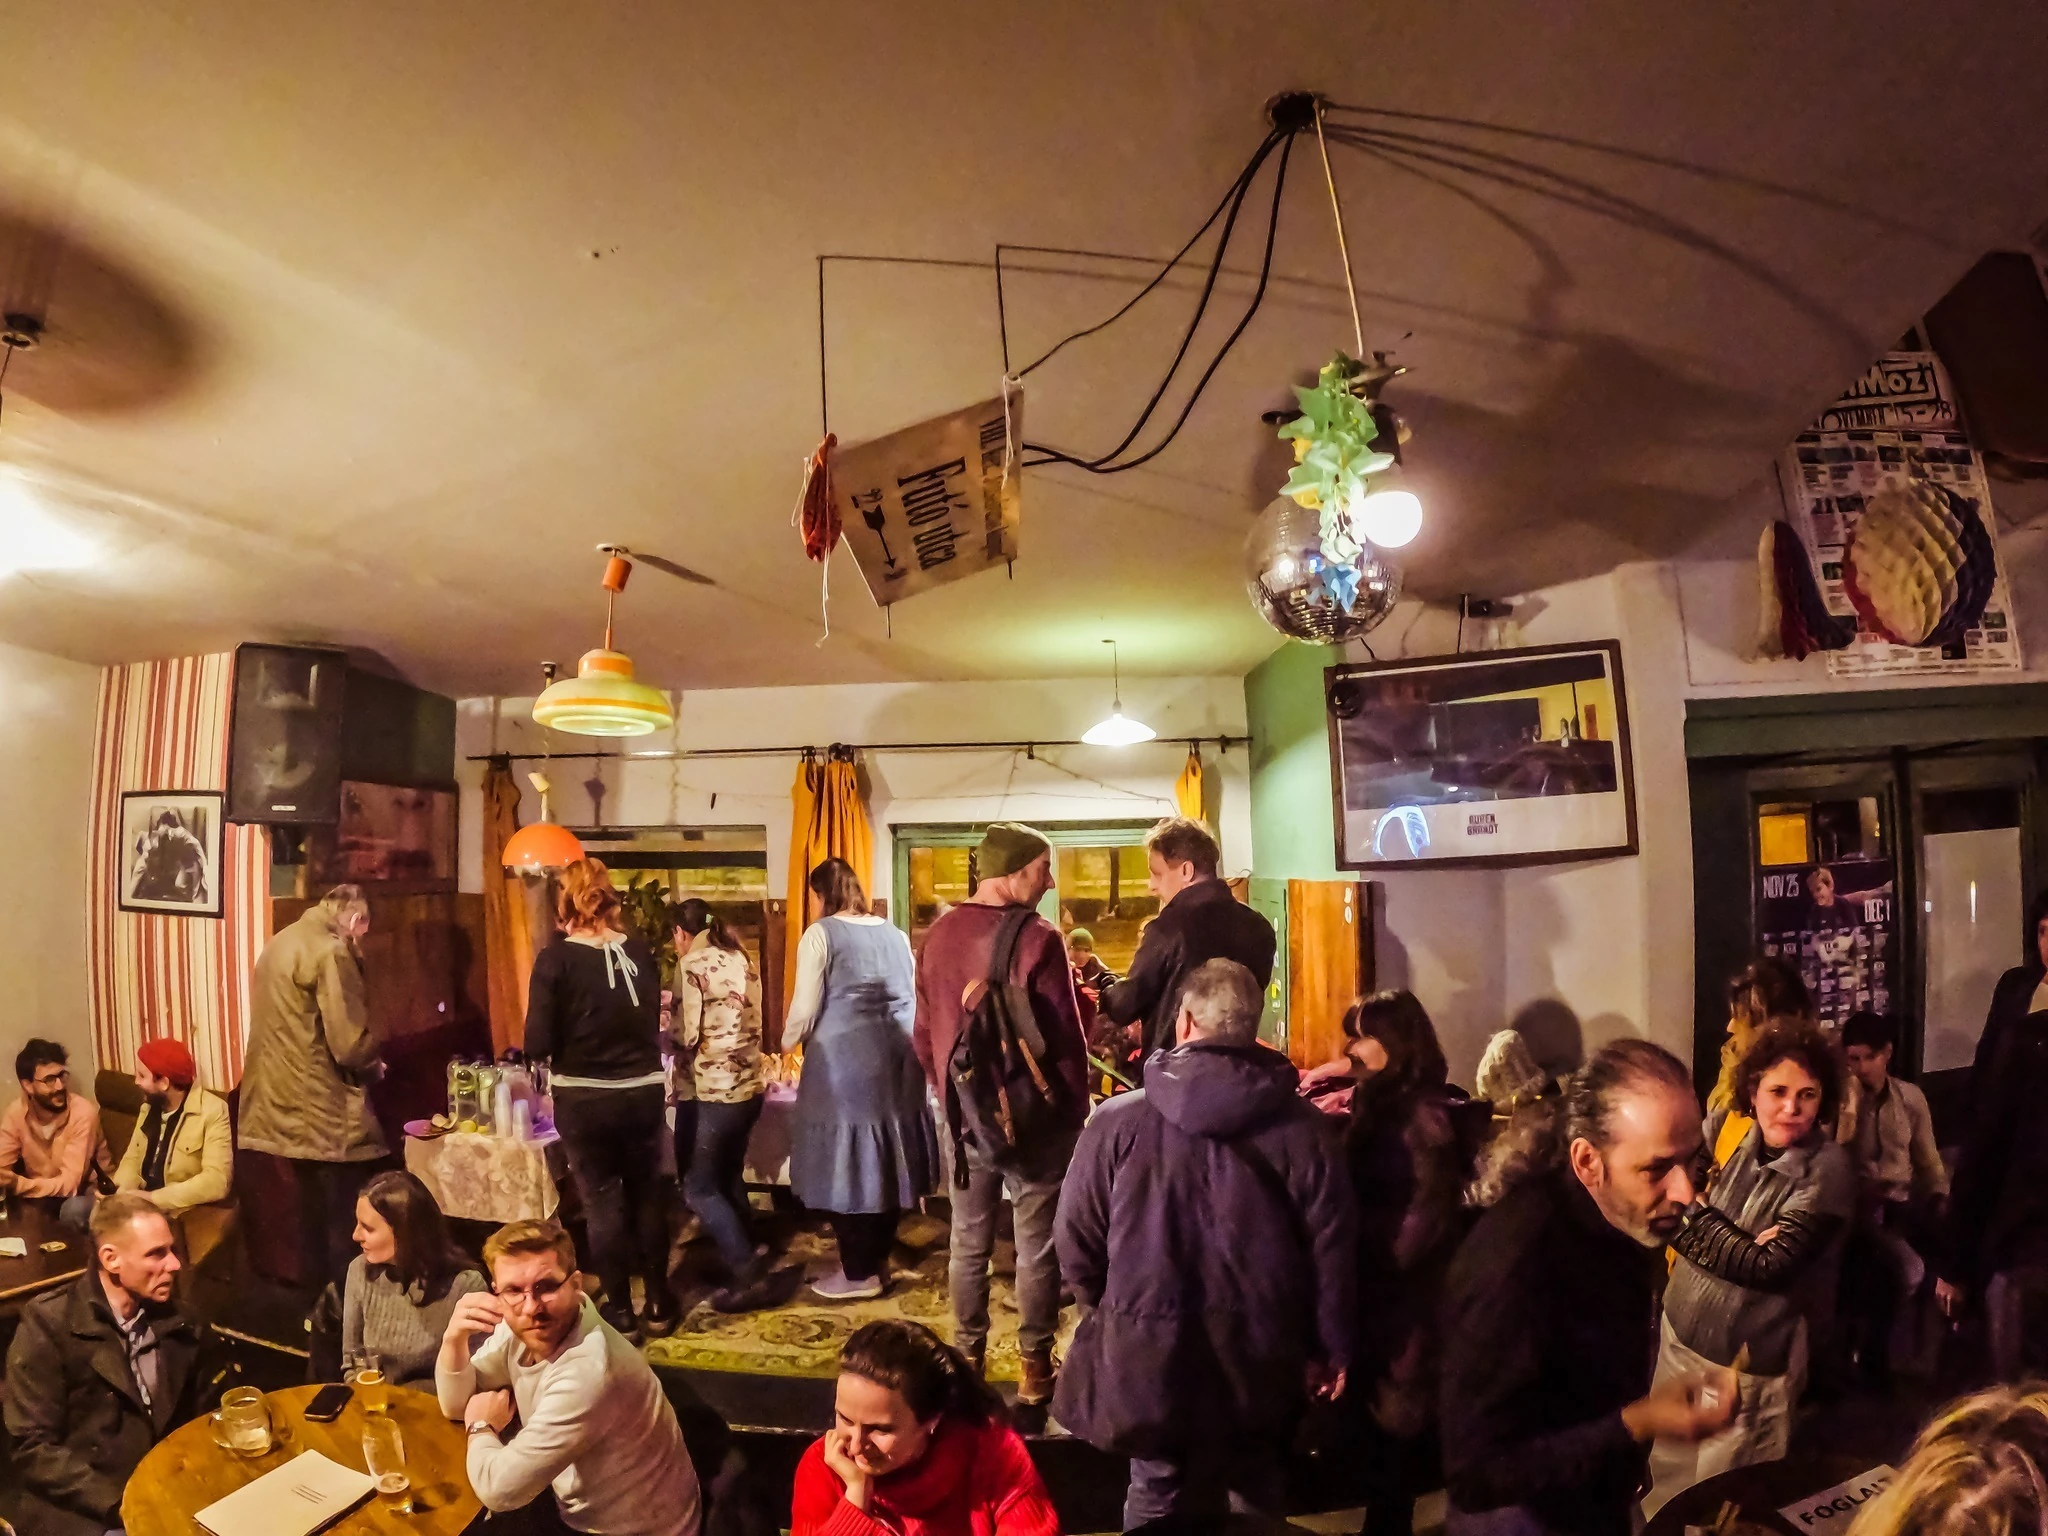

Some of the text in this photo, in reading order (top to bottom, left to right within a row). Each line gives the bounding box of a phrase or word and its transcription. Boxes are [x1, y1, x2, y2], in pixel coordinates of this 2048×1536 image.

[897, 456, 970, 571] Futó utca
[1763, 875, 1784, 899] NOV
[1864, 898, 1884, 923] DEC
